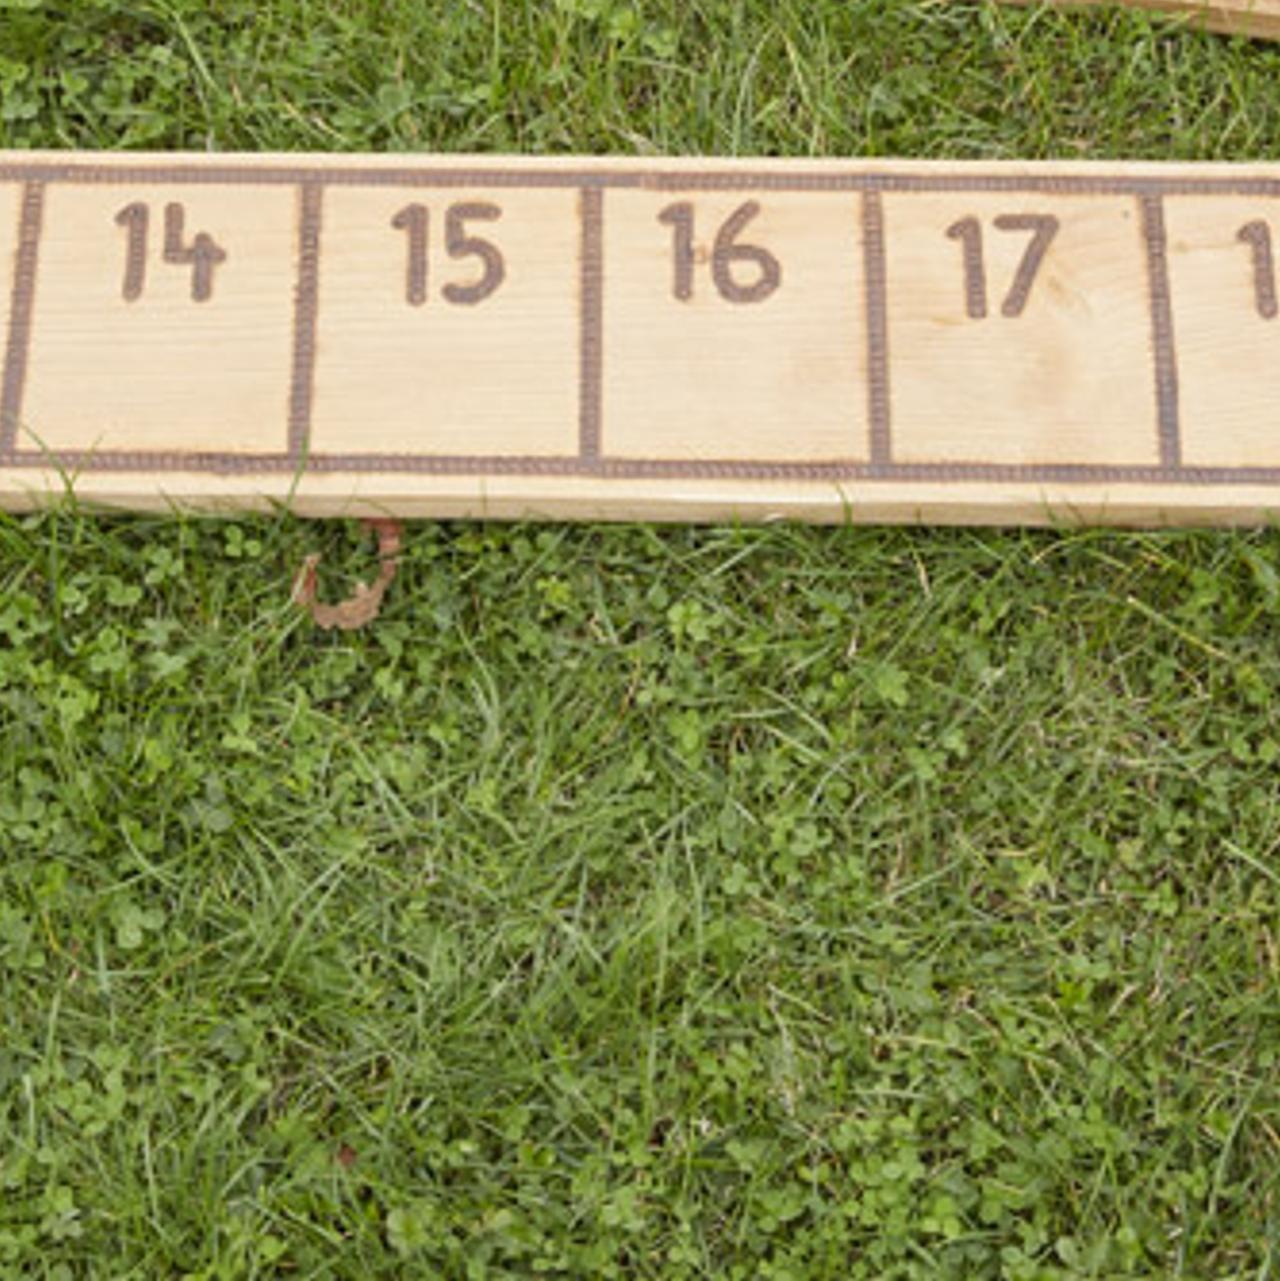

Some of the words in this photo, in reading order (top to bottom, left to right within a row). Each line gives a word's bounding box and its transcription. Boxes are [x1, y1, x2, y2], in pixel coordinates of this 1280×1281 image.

[114, 202, 227, 303] 14
[390, 201, 506, 307] 15
[659, 199, 781, 303] 16
[945, 213, 1060, 320] 17
